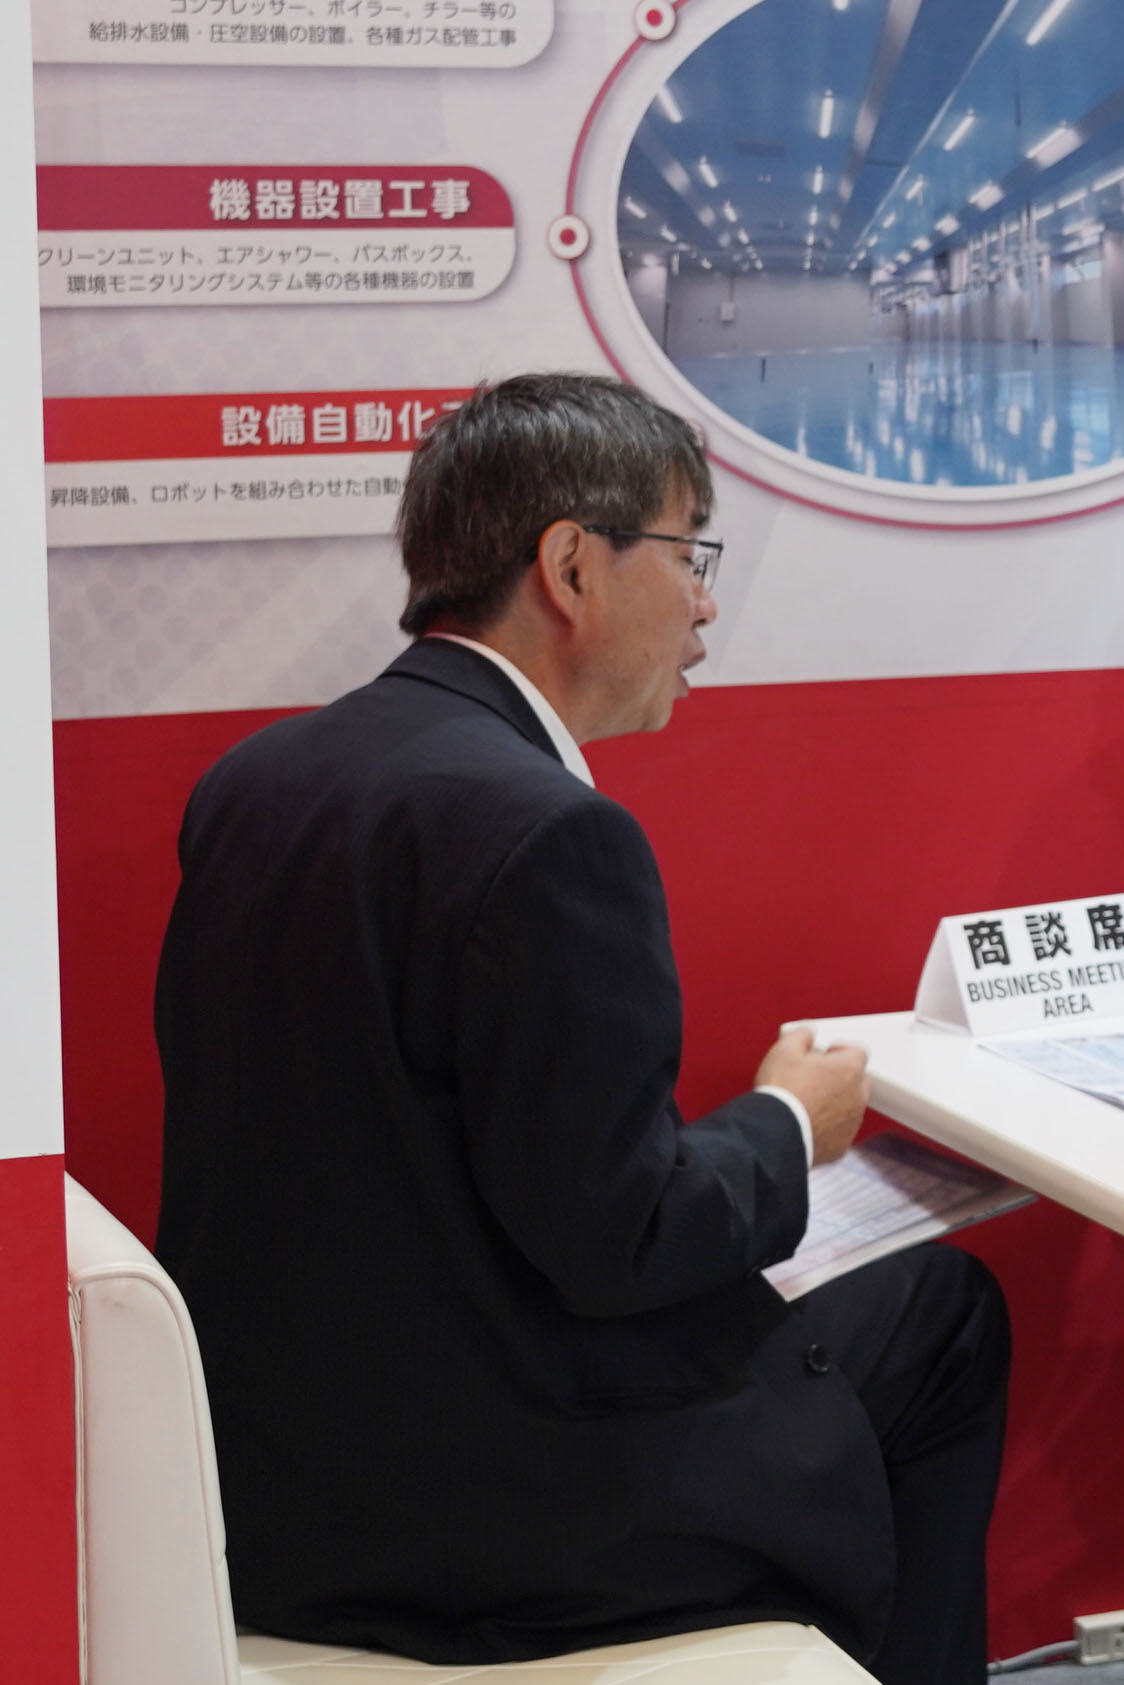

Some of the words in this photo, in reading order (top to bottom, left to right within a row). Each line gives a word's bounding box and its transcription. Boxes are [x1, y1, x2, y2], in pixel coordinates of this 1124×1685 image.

[208, 178, 471, 220] 機器設置工事
[220, 400, 463, 447] 設備自動化
[50, 476, 405, 509] 昇降設備、ロボットを組み合わせた自動
[967, 969, 1063, 1003] BUSINESS
[1043, 993, 1094, 1019] AREA
